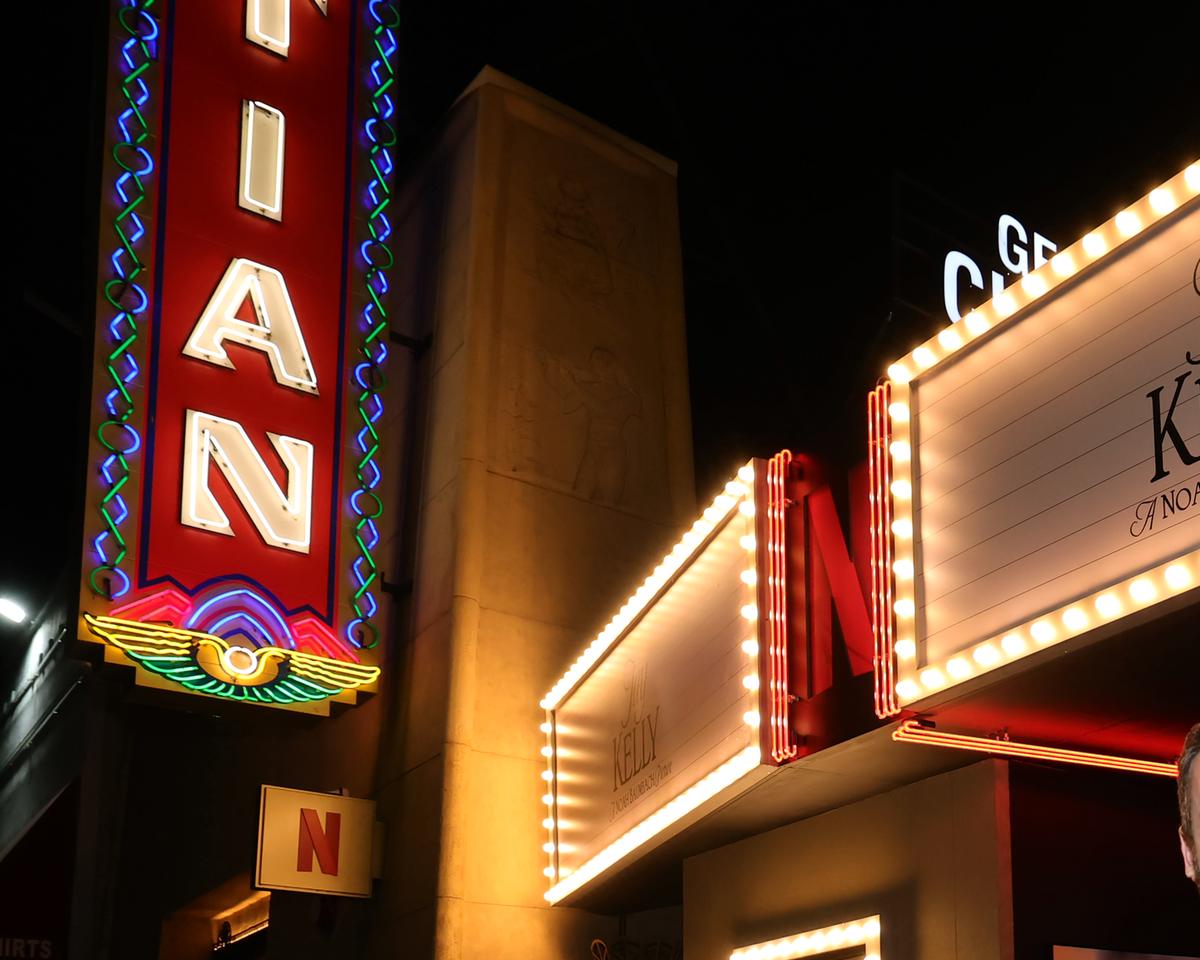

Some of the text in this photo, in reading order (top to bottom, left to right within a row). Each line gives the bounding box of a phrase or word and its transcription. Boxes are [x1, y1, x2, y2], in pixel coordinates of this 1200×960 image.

[1130, 497, 1158, 537] A
[612, 705, 660, 792] KELLY
[296, 807, 342, 877] N
